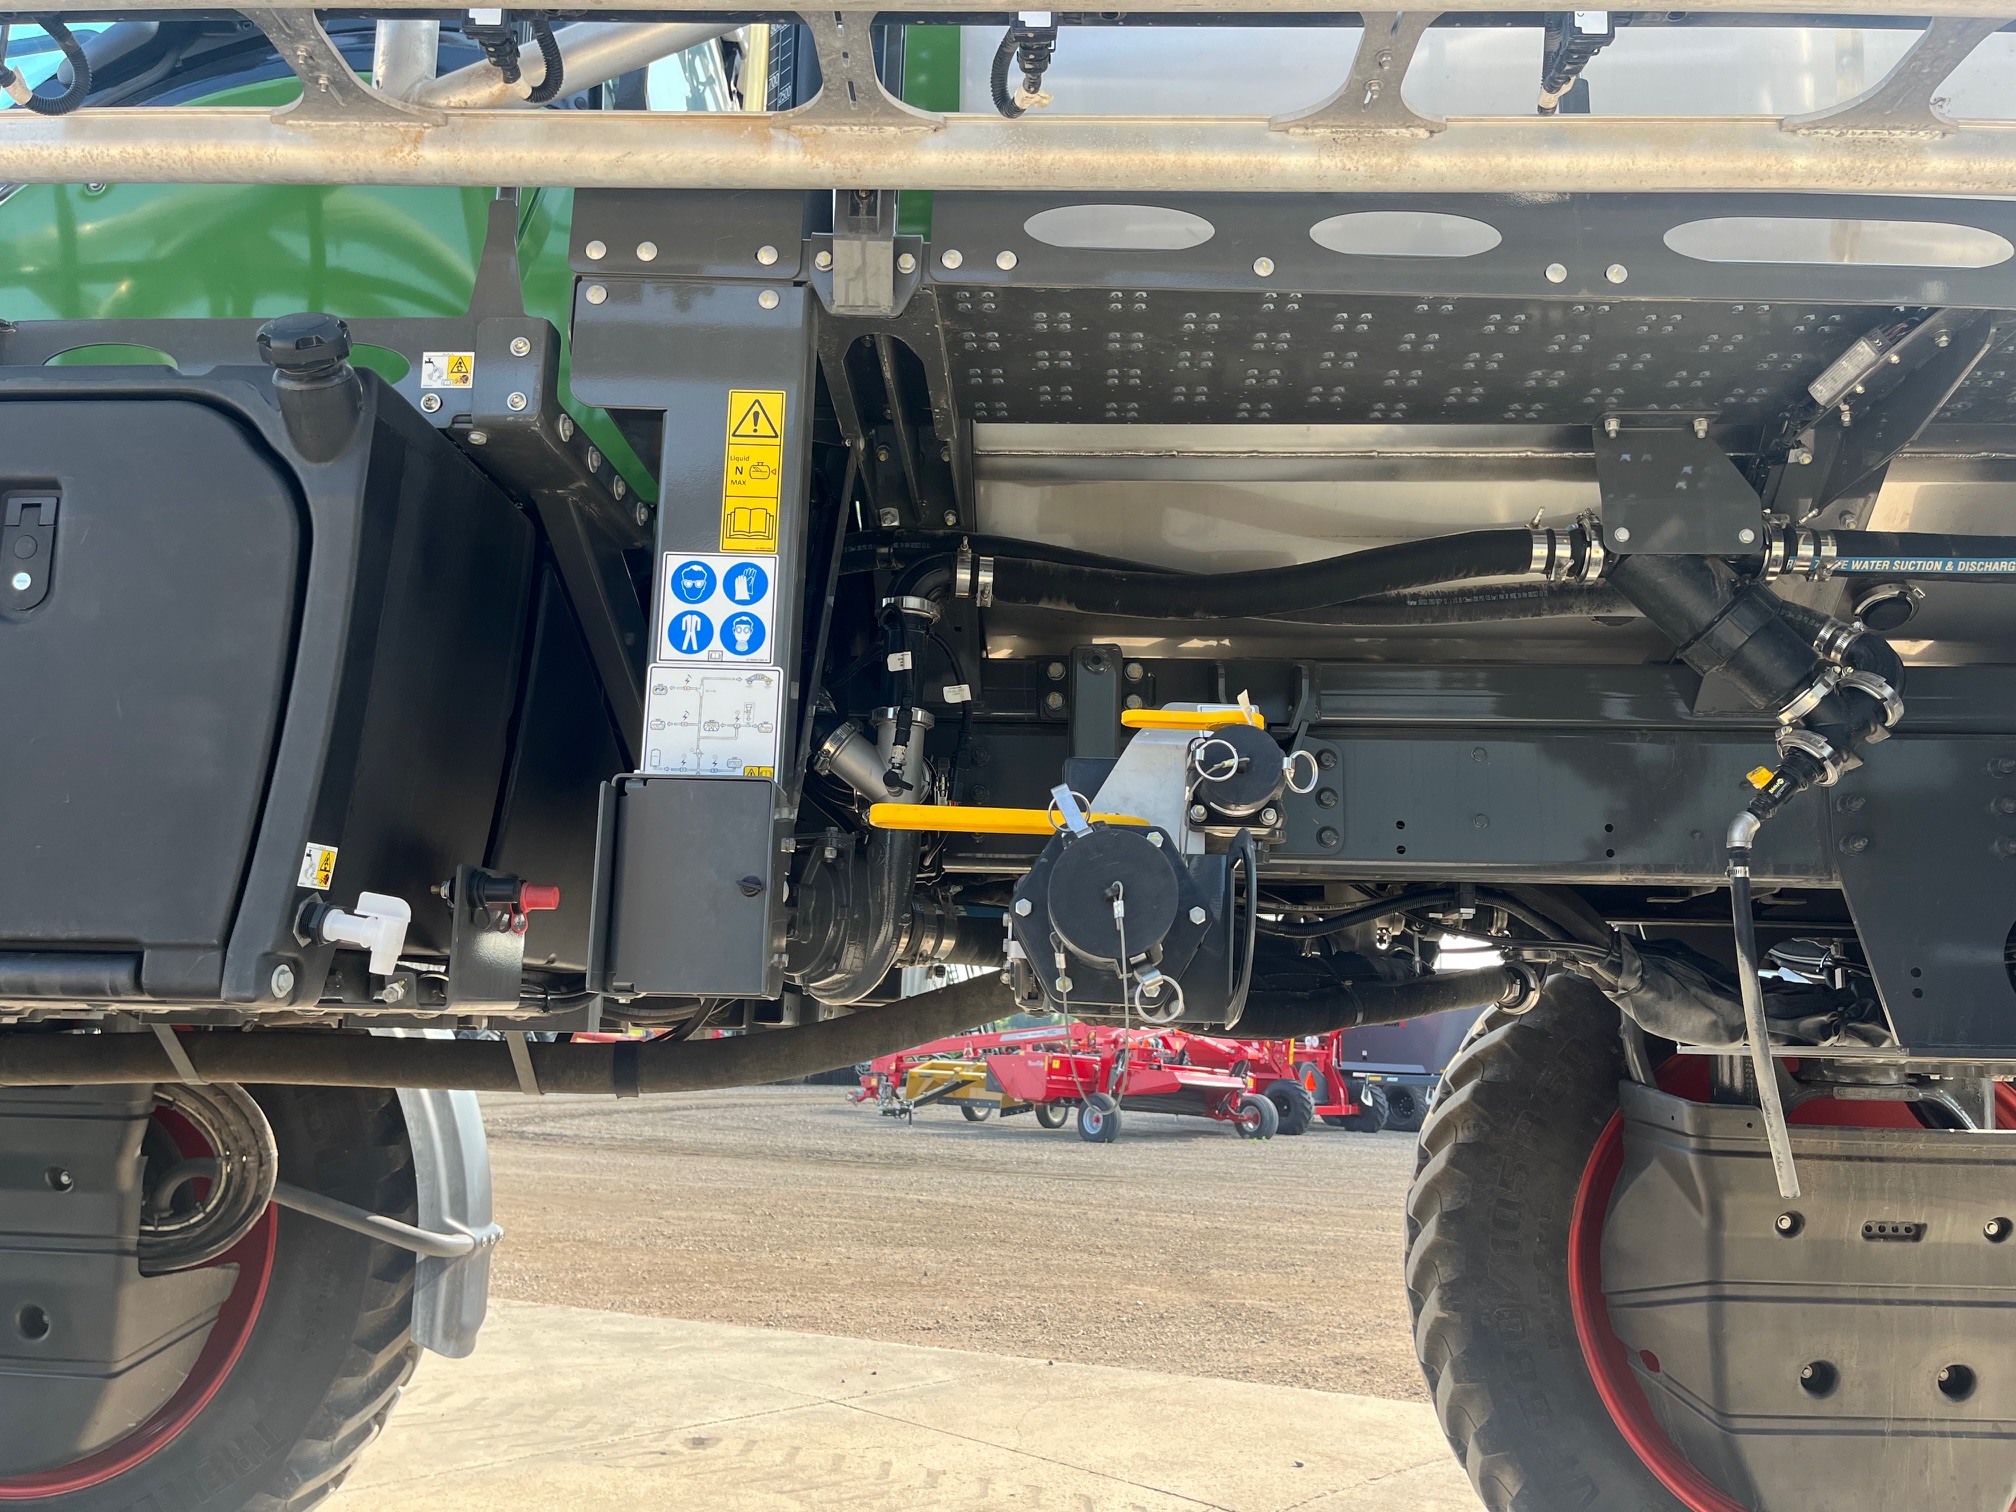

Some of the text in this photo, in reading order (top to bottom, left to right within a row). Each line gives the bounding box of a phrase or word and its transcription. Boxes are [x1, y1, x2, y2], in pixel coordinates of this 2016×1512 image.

[769, 73, 779, 89] 700
[735, 466, 743, 475] N
[1851, 560, 1890, 570] WATER
[1893, 560, 1942, 570] SUCTION
[1945, 561, 1953, 571] &
[1957, 561, 2016, 572] DISCHARG
